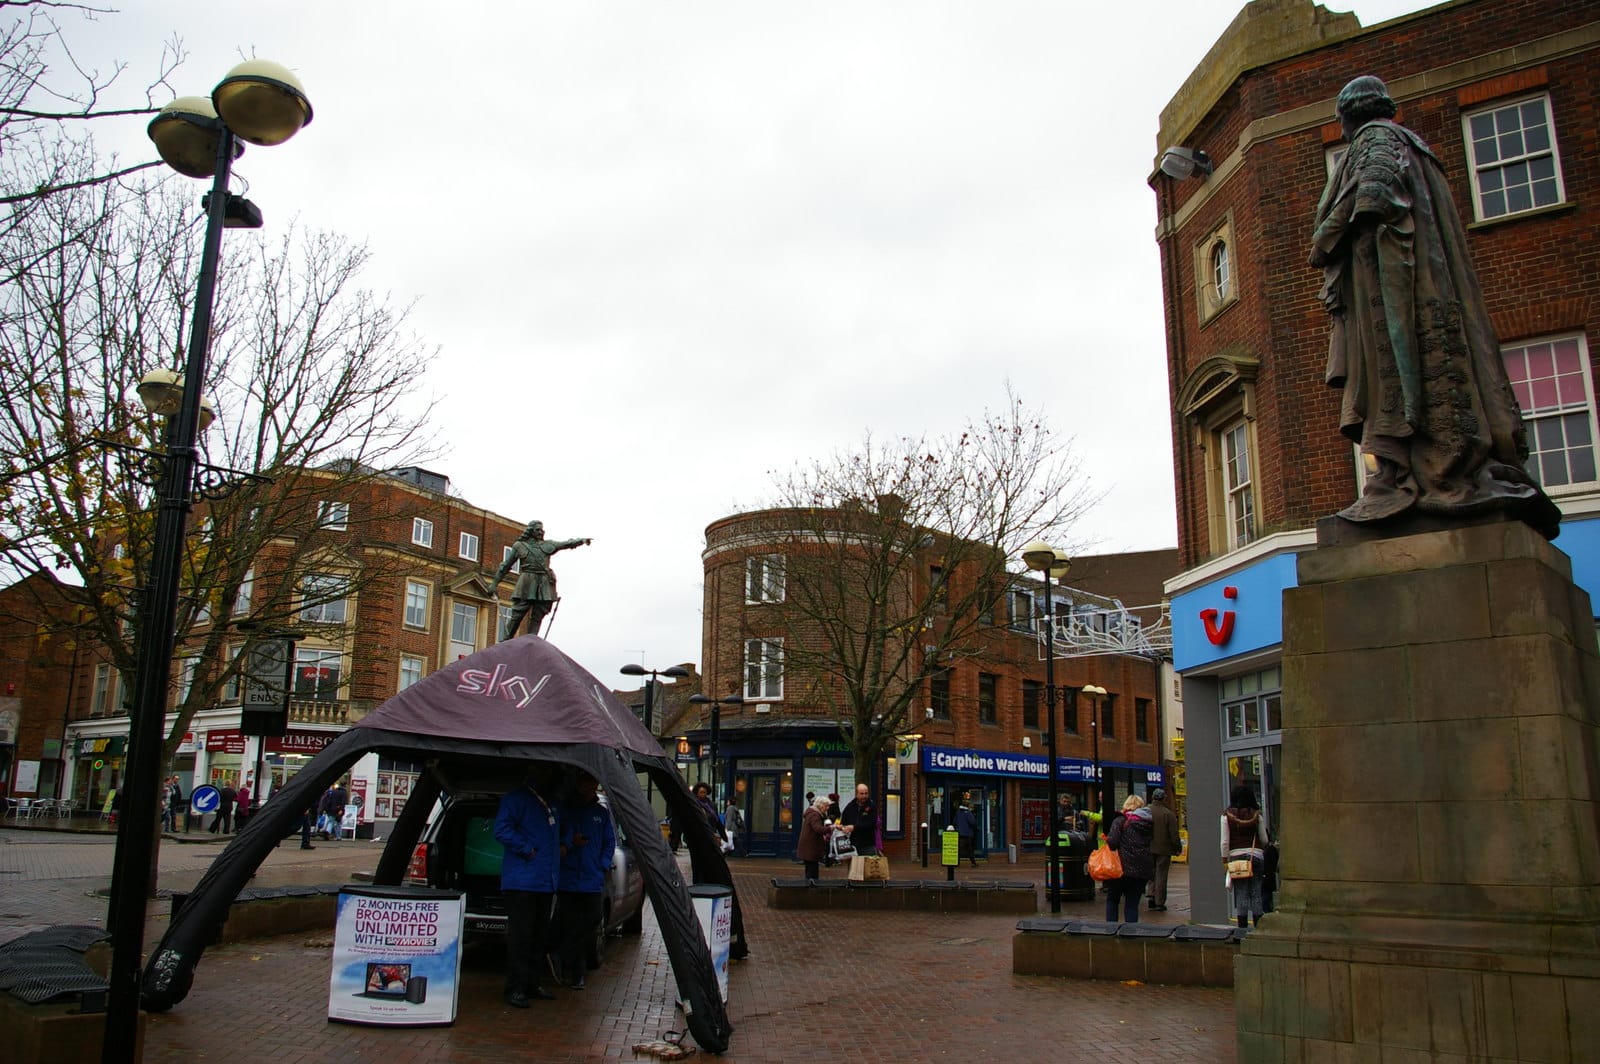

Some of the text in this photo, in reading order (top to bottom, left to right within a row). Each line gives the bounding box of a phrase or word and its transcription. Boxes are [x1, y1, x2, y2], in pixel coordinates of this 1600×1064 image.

[456, 663, 552, 709] sky
[281, 735, 336, 746] TIMPSO
[937, 752, 994, 771] Carphone
[996, 758, 1050, 774] Warehous
[358, 899, 439, 911] 12 MONTHS FREE
[356, 908, 438, 923] BROADBAND
[355, 920, 437, 936] UNLIMITED
[355, 933, 382, 945] WITH
